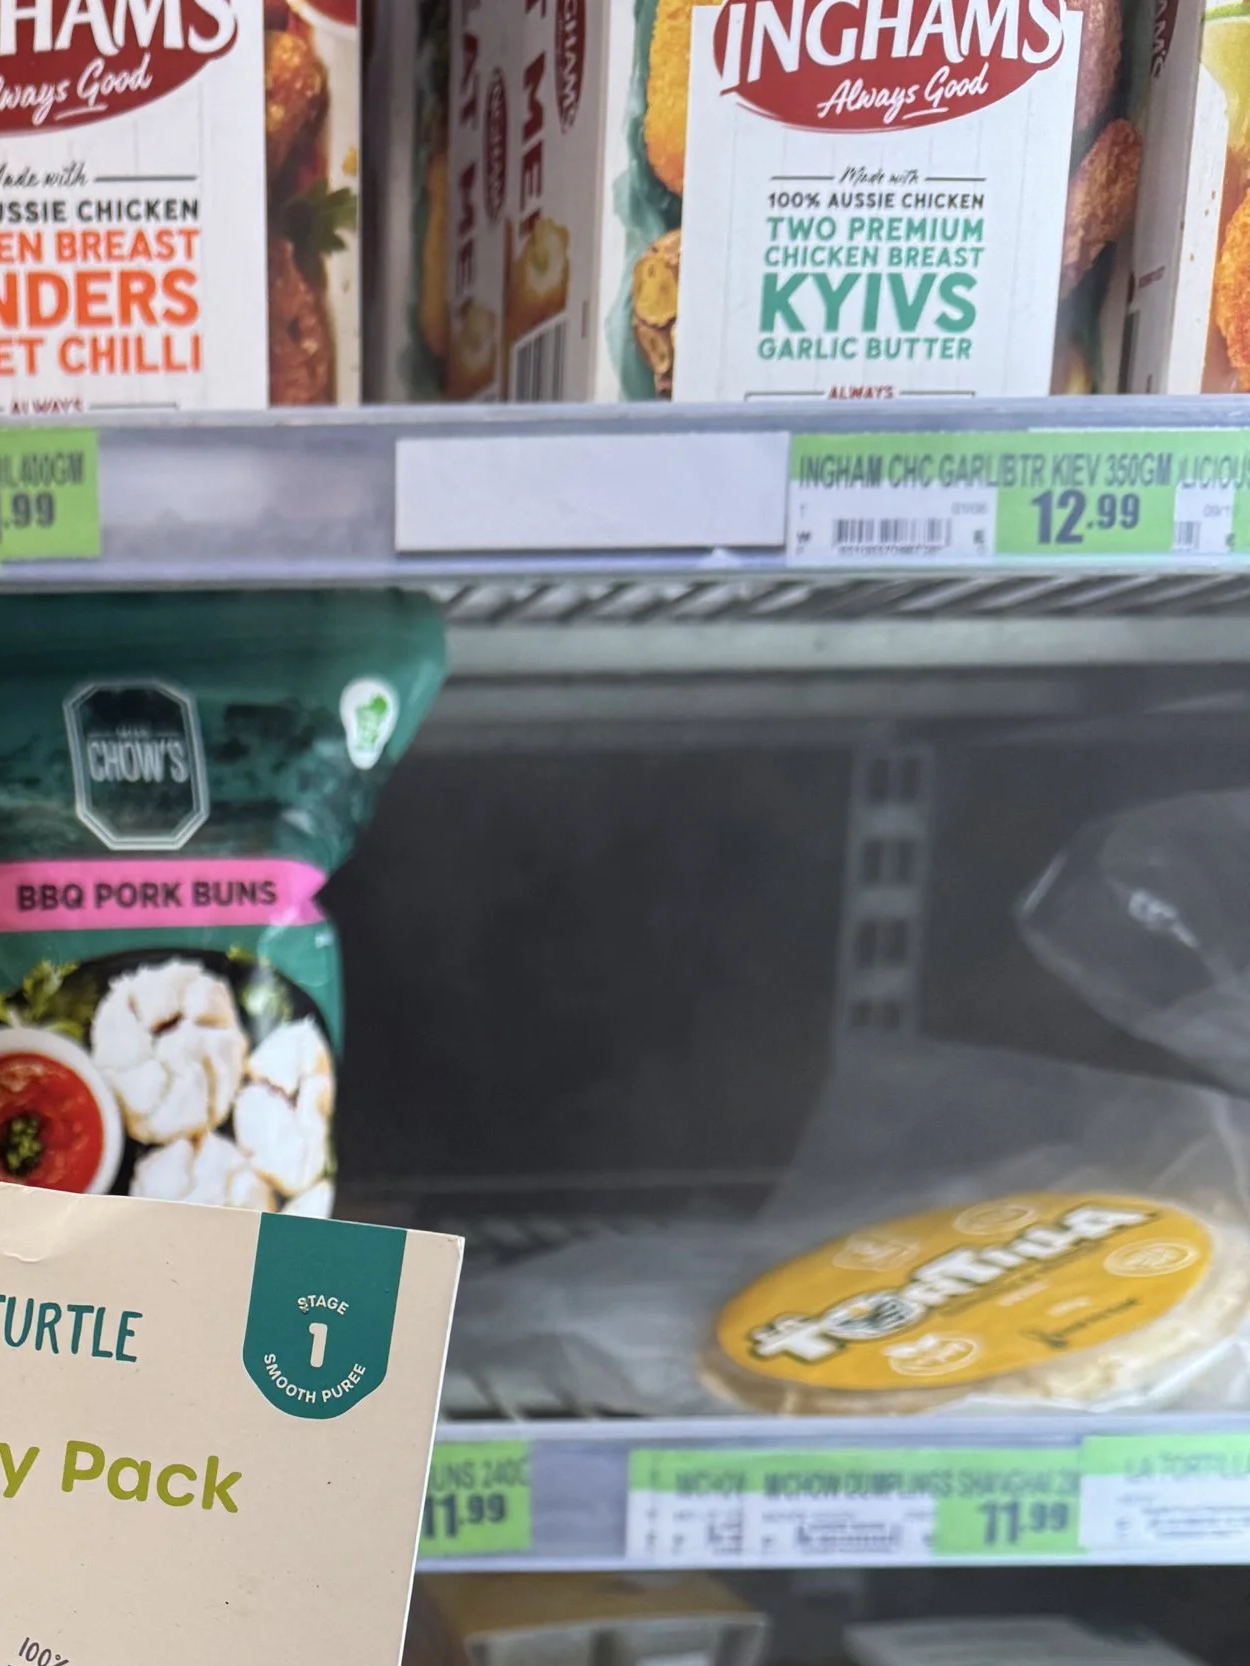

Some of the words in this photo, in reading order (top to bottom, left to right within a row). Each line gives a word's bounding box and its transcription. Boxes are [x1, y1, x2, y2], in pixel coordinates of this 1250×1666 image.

[76, 54, 153, 102] Good
[817, 80, 918, 124] Always
[923, 63, 988, 102] Good
[44, 162, 90, 187] with
[839, 166, 886, 185] Made
[888, 168, 919, 186] with
[76, 199, 198, 223] CHICKEN
[768, 192, 820, 209] 100%
[828, 192, 894, 209] AUSSIE
[902, 193, 985, 210] CHICKEN
[54, 228, 200, 264] BREAST
[766, 216, 837, 242] TWO
[847, 216, 985, 243] PREMIUM
[764, 246, 880, 268] CHICKEN
[887, 246, 986, 268] BREAST
[758, 271, 978, 334] KYIVS
[57, 333, 202, 376] CHILLI
[757, 337, 859, 360] GARLIC
[866, 337, 973, 360] BUTTER
[828, 385, 894, 400] ALWAYS
[800, 454, 884, 490] INGHAM
[888, 454, 933, 489] CHC
[1051, 453, 1101, 487] KIEV
[1105, 451, 1172, 487] 350GM
[1031, 488, 1141, 546] 12.99
[86, 738, 190, 784] CHOW'S
[15, 882, 85, 913] BBQ
[94, 880, 183, 910] PORK
[191, 879, 278, 908] BUNS
[297, 1295, 349, 1315] STAGE
[308, 1322, 328, 1368] 1
[263, 1353, 317, 1404] SMOOTH
[321, 1363, 367, 1403] PUREE
[60, 1440, 243, 1514] Pack
[429, 1458, 476, 1493] UNS
[424, 1493, 507, 1540] 11.99
[976, 1498, 1070, 1547] 11.99
